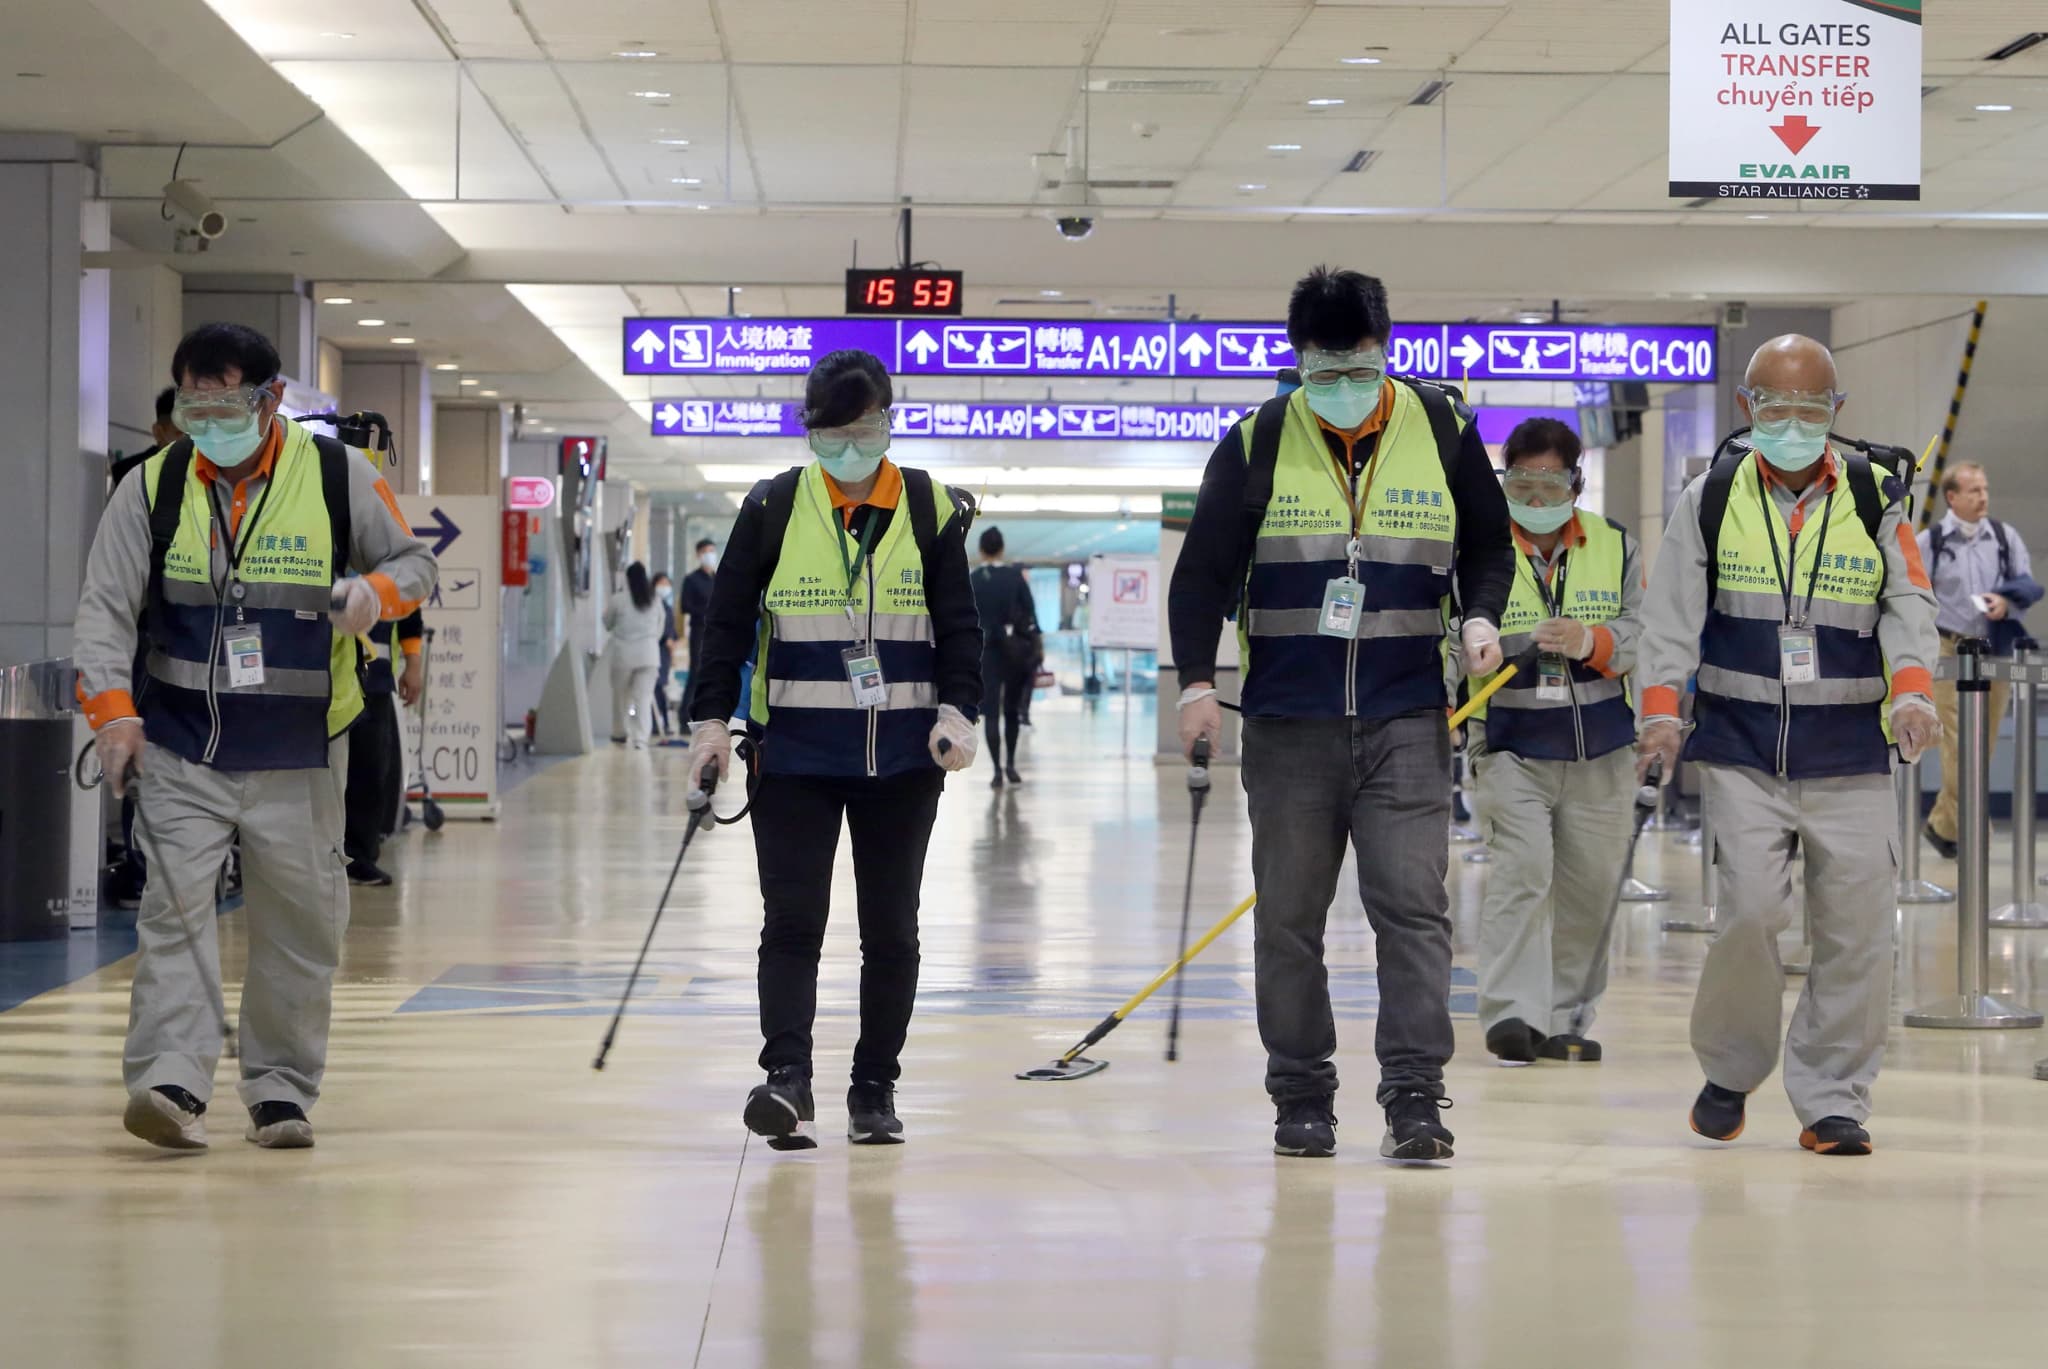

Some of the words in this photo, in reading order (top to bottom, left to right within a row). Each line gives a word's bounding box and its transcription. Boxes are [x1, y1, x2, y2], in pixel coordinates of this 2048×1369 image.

[1720, 23, 1771, 45] ALL
[1779, 23, 1871, 46] GATES
[1721, 54, 1870, 77] TRANSFER
[1717, 80, 1813, 112] chuyển
[1821, 82, 1874, 113] tiếp
[1718, 184, 1761, 197] STAR
[1766, 185, 1850, 198] ALLIANCE
[866, 278, 896, 305] 15
[913, 279, 953, 306] 53
[715, 326, 813, 351] 入境檢查
[715, 352, 811, 372] Immigration
[1085, 335, 1168, 371] A1-A9
[1387, 337, 1440, 375] -D10
[1629, 340, 1713, 377] C1-C10
[968, 409, 1026, 435] A1-A9
[1155, 411, 1213, 438] D1-D10
